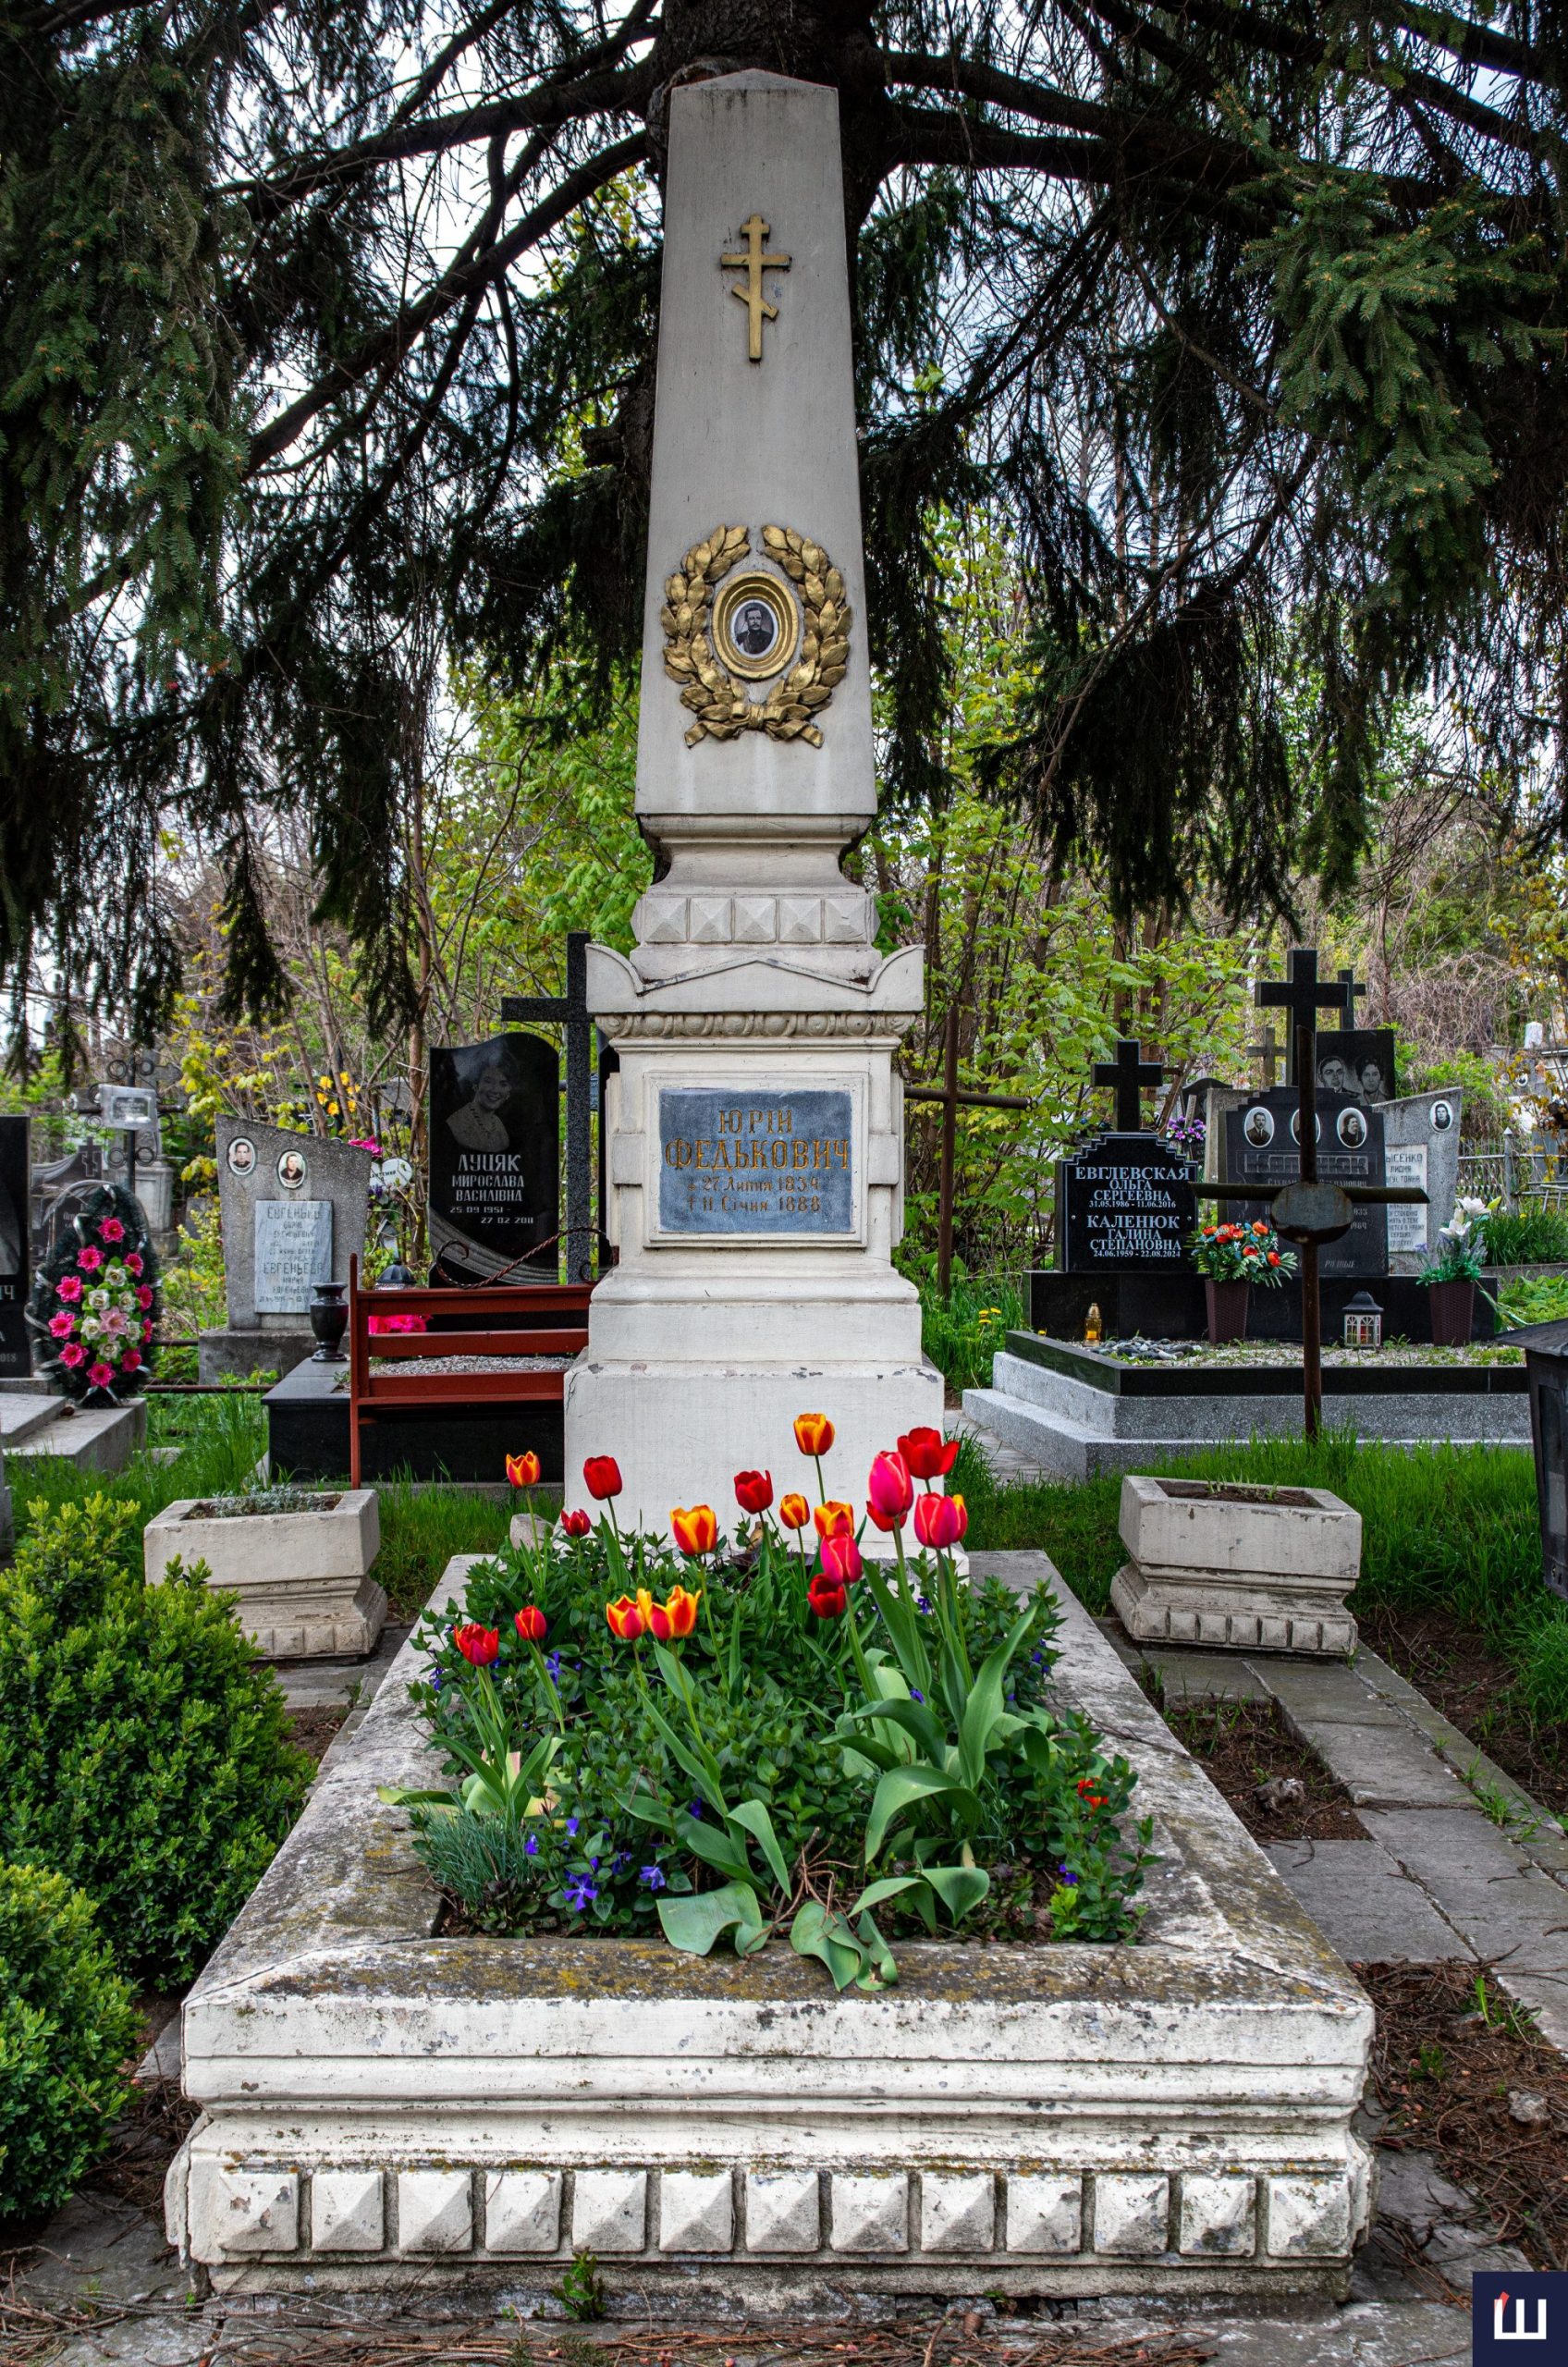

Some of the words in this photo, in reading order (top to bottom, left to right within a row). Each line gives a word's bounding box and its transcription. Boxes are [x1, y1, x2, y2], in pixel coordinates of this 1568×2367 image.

[665, 1137, 849, 1171] ФЕДЬКОВИЧ
[1385, 1153, 1423, 1163] ЫСЕНКО
[458, 1153, 521, 1171] ЛУЦЯК
[1244, 1154, 1368, 1175] КАЛНЮК
[1074, 1166, 1191, 1181] ЕВГЛЕВСКАЯ
[451, 1174, 525, 1188] МИРОСЛАВА
[778, 1175, 820, 1193] 1834
[1109, 1179, 1153, 1191] ОЛЬГА
[456, 1189, 523, 1202] ВАСИЛІВНА
[1094, 1190, 1172, 1201] СЕРГЕЕВНА
[449, 1206, 462, 1214] 25
[466, 1206, 480, 1214] 09
[484, 1206, 504, 1214] 1951
[778, 1195, 821, 1212] 1888
[481, 1216, 494, 1224] 27
[497, 1216, 511, 1224] 02
[1086, 1214, 1181, 1229] КАЛЕНЮК
[1108, 1229, 1162, 1240] ГАЛИНА
[1089, 1239, 1182, 1250] СТЕПАНОВНА
